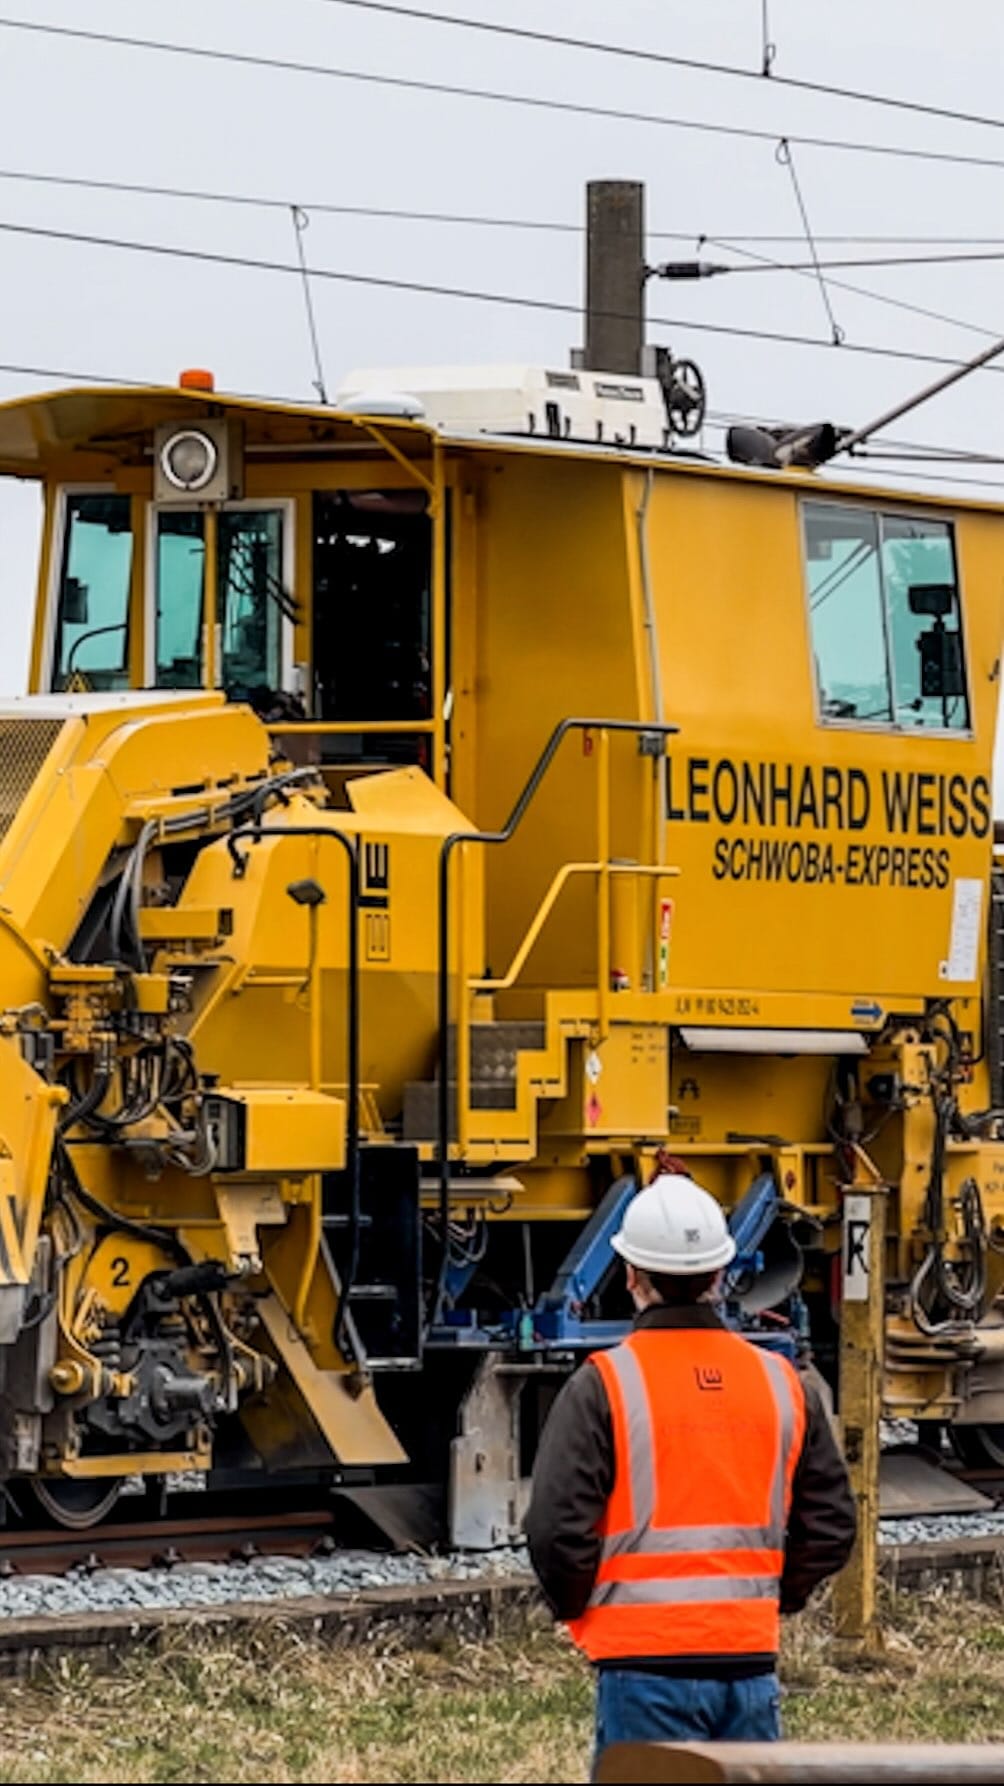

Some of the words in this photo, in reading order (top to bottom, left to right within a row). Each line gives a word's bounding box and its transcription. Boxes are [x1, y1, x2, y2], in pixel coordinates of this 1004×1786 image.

[665, 756, 870, 830] LEONHARD
[882, 771, 990, 838] WEISS
[713, 838, 950, 889] SCHWOBA-EXPRESS
[110, 1257, 130, 1287] 2
[848, 1220, 870, 1275] R
